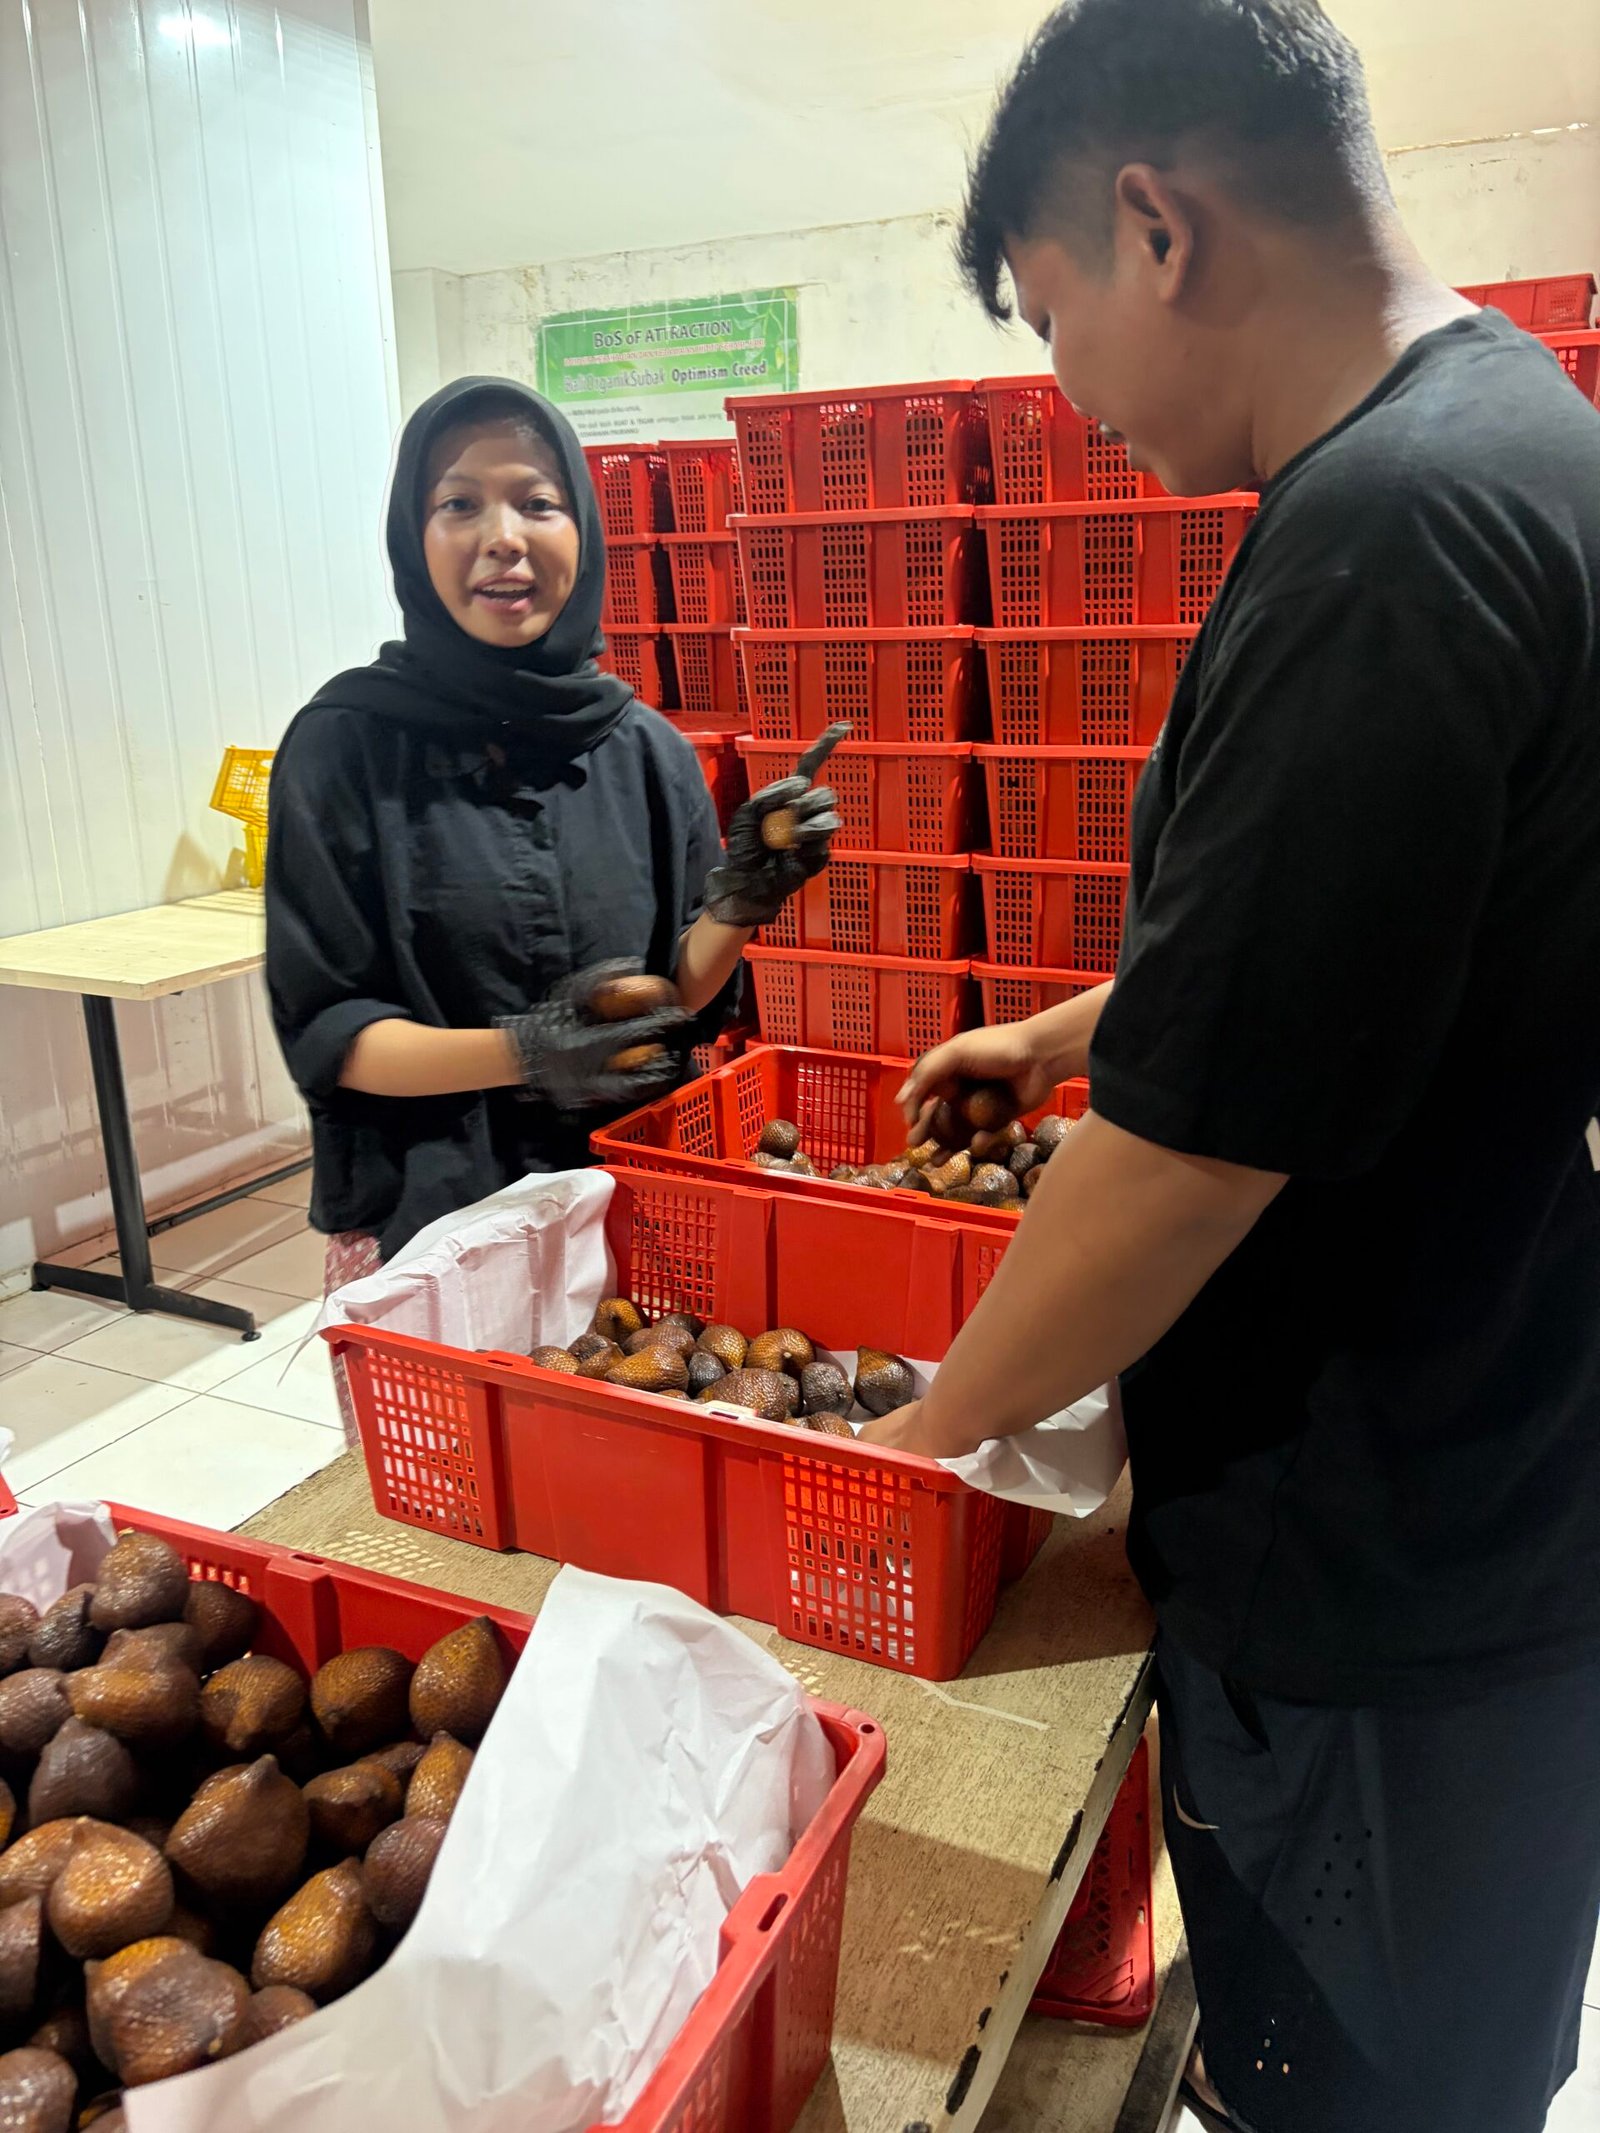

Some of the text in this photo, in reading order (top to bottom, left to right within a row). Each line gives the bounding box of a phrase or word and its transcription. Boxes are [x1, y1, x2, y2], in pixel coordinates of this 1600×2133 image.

[645, 320, 732, 343] ATTRACTION
[672, 366, 728, 385] Optimism
[732, 360, 767, 376] Creed
